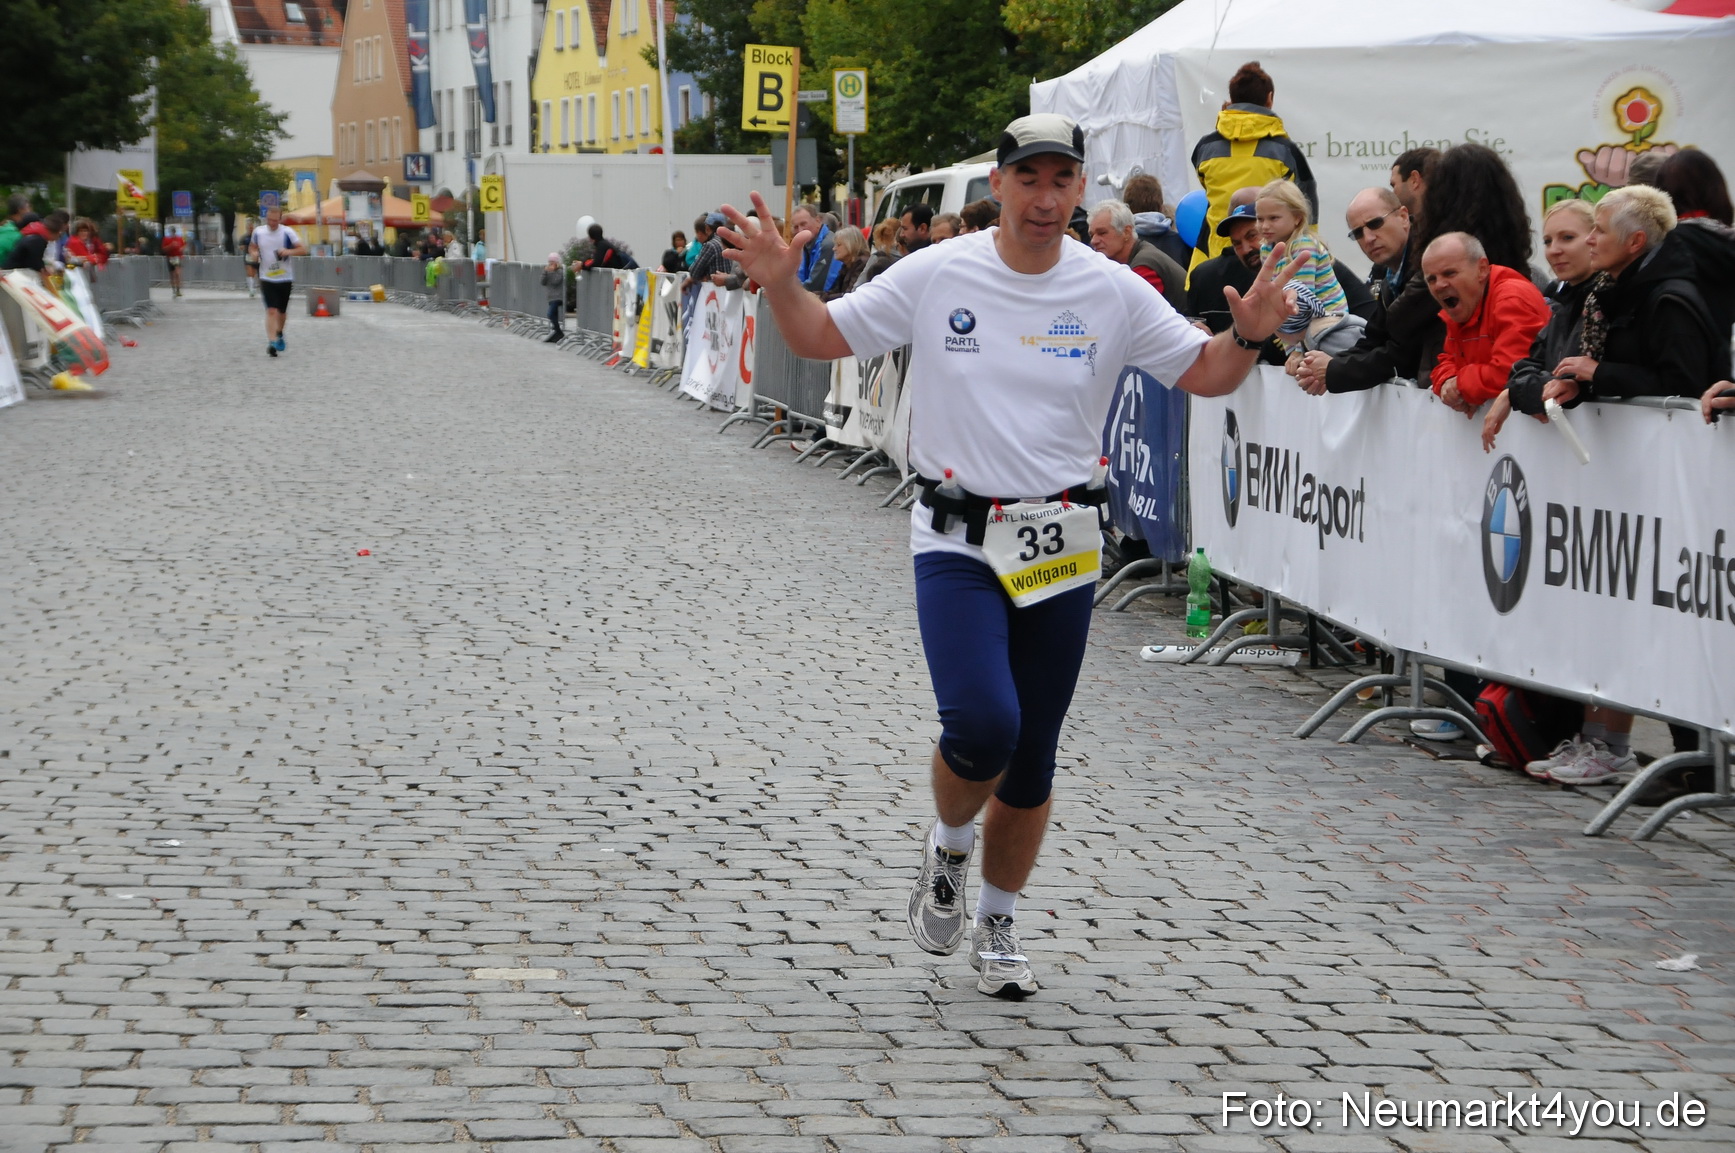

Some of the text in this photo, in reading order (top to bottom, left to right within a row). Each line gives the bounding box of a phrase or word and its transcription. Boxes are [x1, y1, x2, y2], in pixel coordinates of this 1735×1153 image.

[752, 48, 793, 66] Block
[757, 71, 784, 112] B
[844, 79, 856, 92] H
[485, 186, 498, 204] C
[416, 201, 426, 216] D
[945, 336, 980, 347] PARTL
[945, 345, 980, 354] Neumarkt
[1246, 442, 1290, 516] BMW
[1487, 460, 1528, 512] BMW
[1017, 522, 1065, 562] 33
[1545, 502, 1645, 601] BMW
[1011, 561, 1077, 592] Wolfgang
